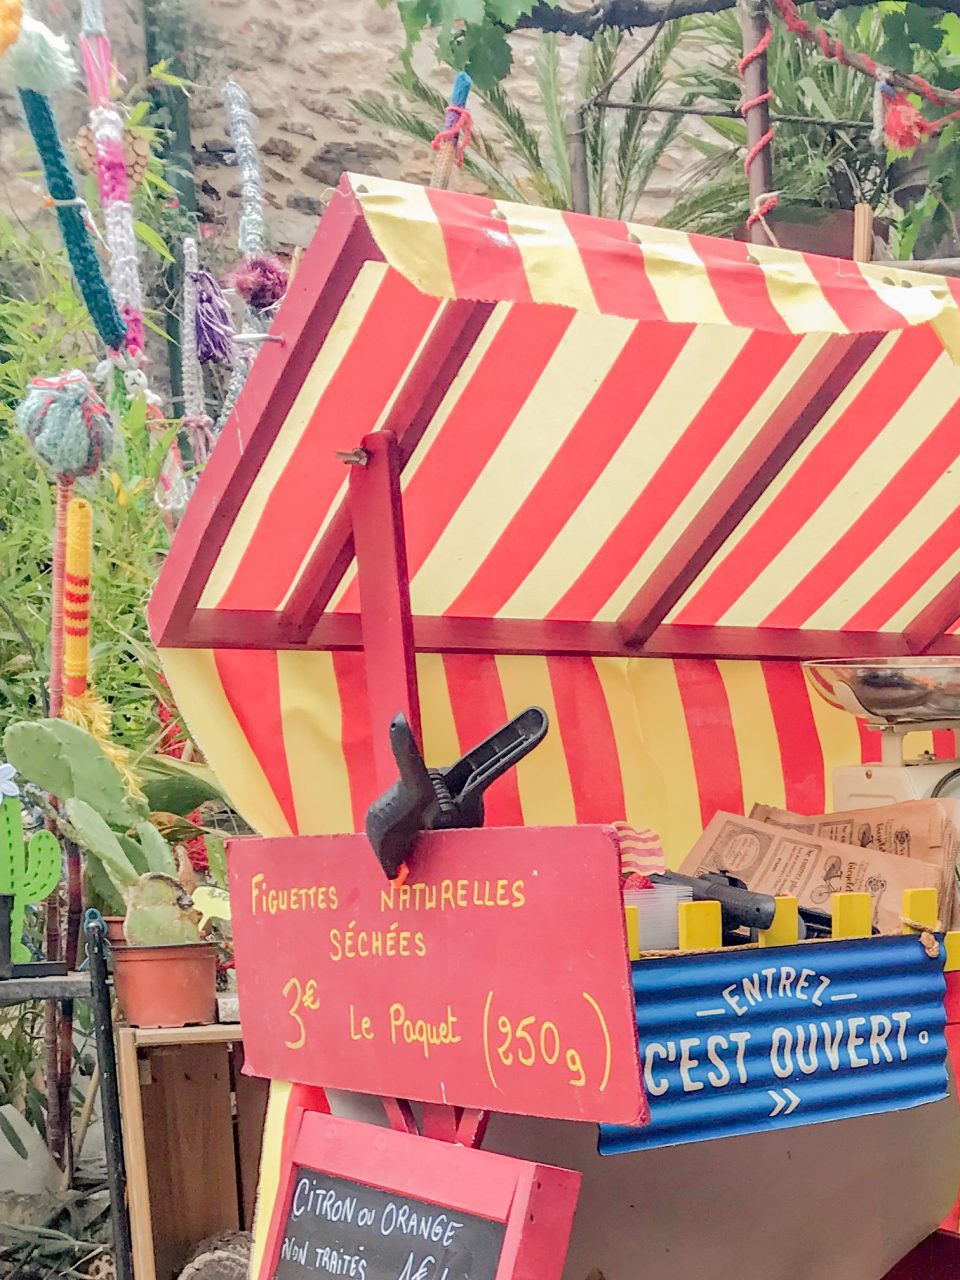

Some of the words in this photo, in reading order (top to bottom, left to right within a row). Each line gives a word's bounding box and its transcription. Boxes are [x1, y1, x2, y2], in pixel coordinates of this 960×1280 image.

[381, 880, 526, 912] NATURELLES
[330, 921, 427, 961] SÉCHÉES
[722, 966, 831, 1016] ENTREZ
[282, 977, 320, 1049] 3€
[350, 1004, 374, 1040] Le
[390, 1003, 461, 1058] Paquet
[644, 1031, 750, 1096] C'EST
[381, 1202, 463, 1246] ORANGE
[282, 1238, 309, 1265] NON
